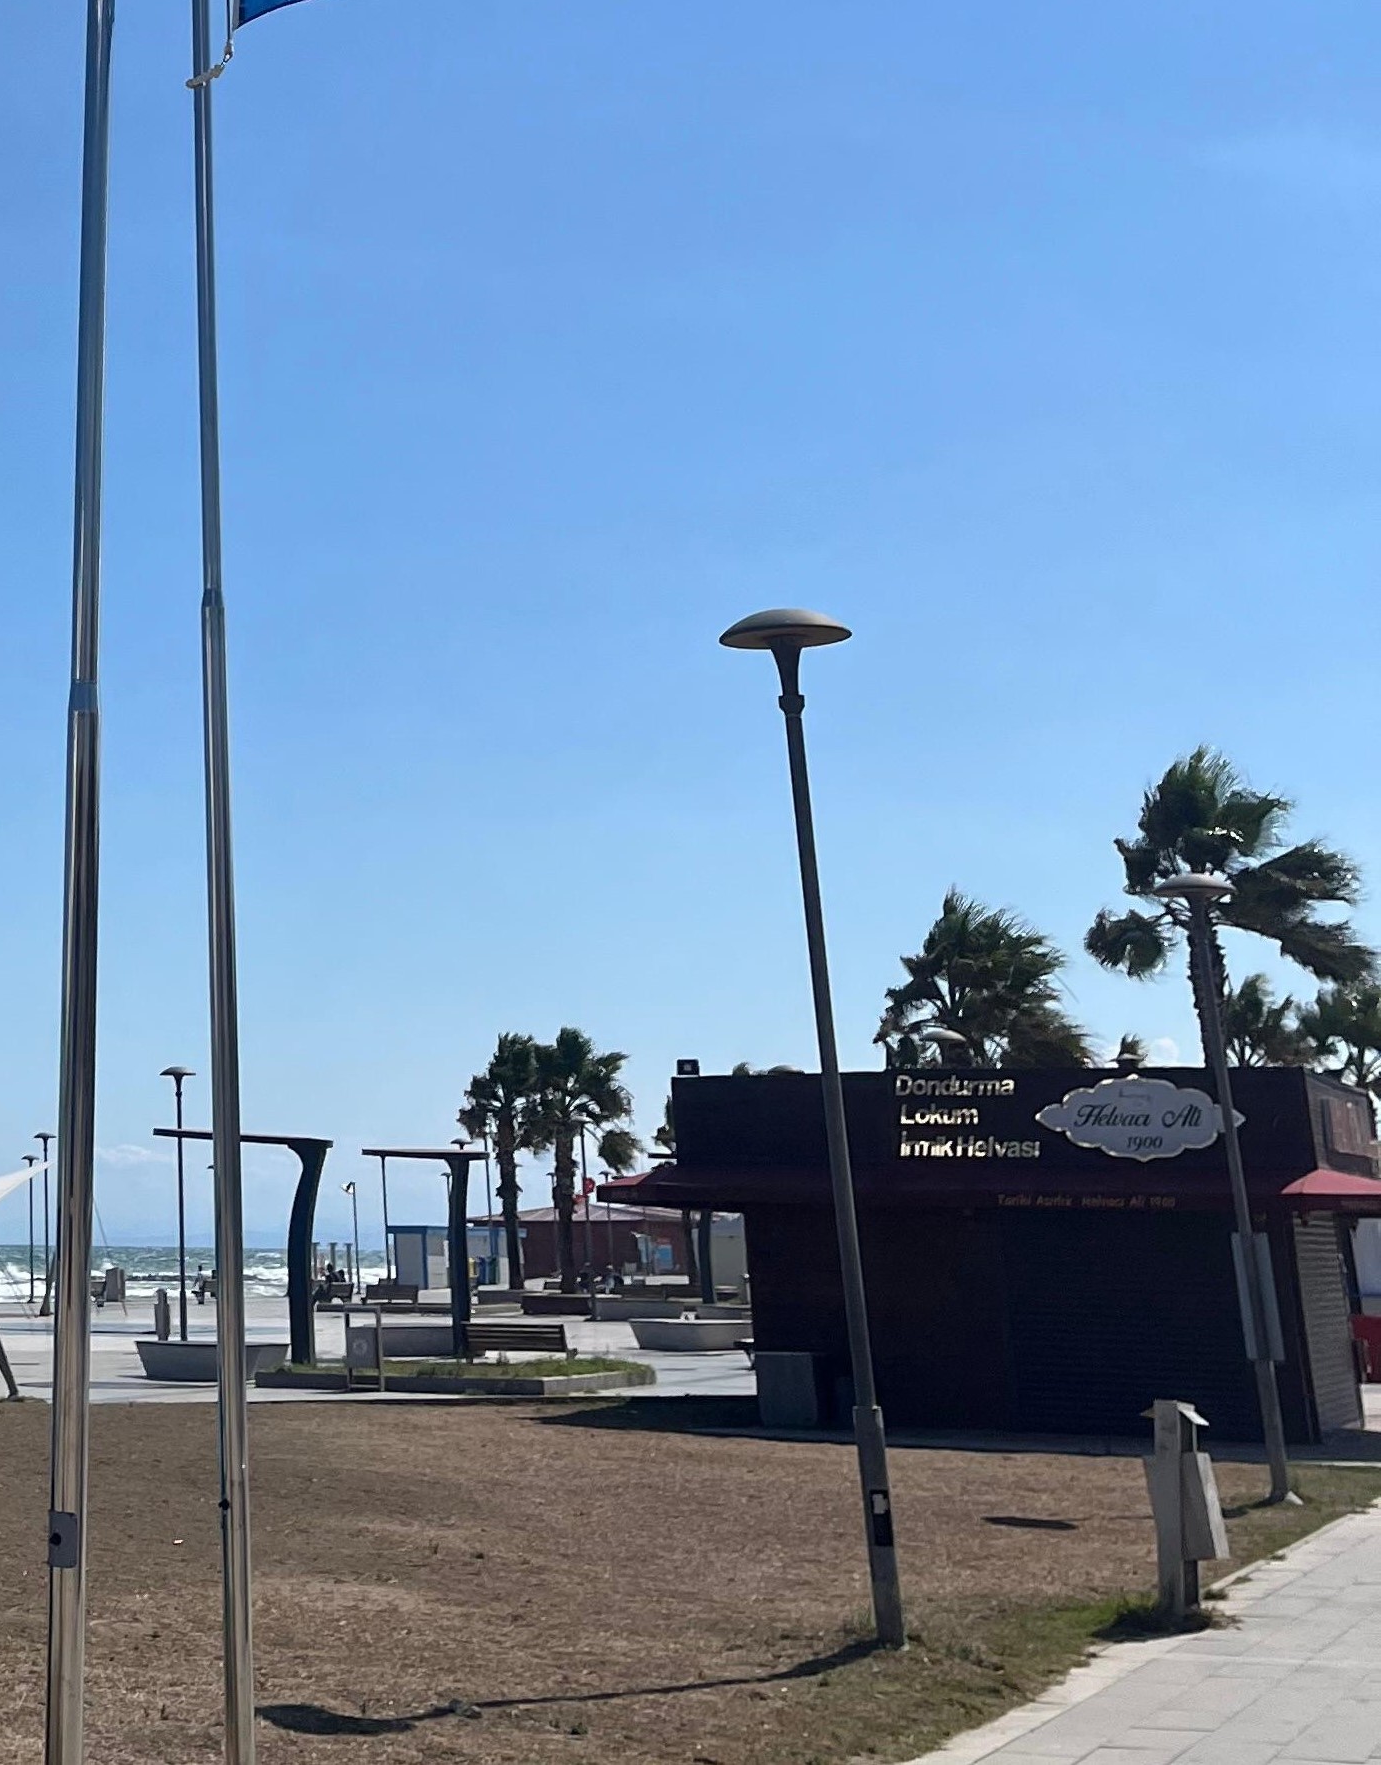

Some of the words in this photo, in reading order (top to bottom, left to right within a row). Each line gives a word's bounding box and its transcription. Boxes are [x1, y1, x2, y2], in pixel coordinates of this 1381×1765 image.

[894, 1074, 1016, 1097] Dondurma
[900, 1102, 979, 1126] Lokum
[1073, 1103, 1152, 1129] Helvacı
[1161, 1103, 1204, 1129] Ali
[899, 1132, 954, 1159] İrmik
[956, 1135, 1041, 1159] Helvası
[1125, 1136, 1163, 1152] 1900
